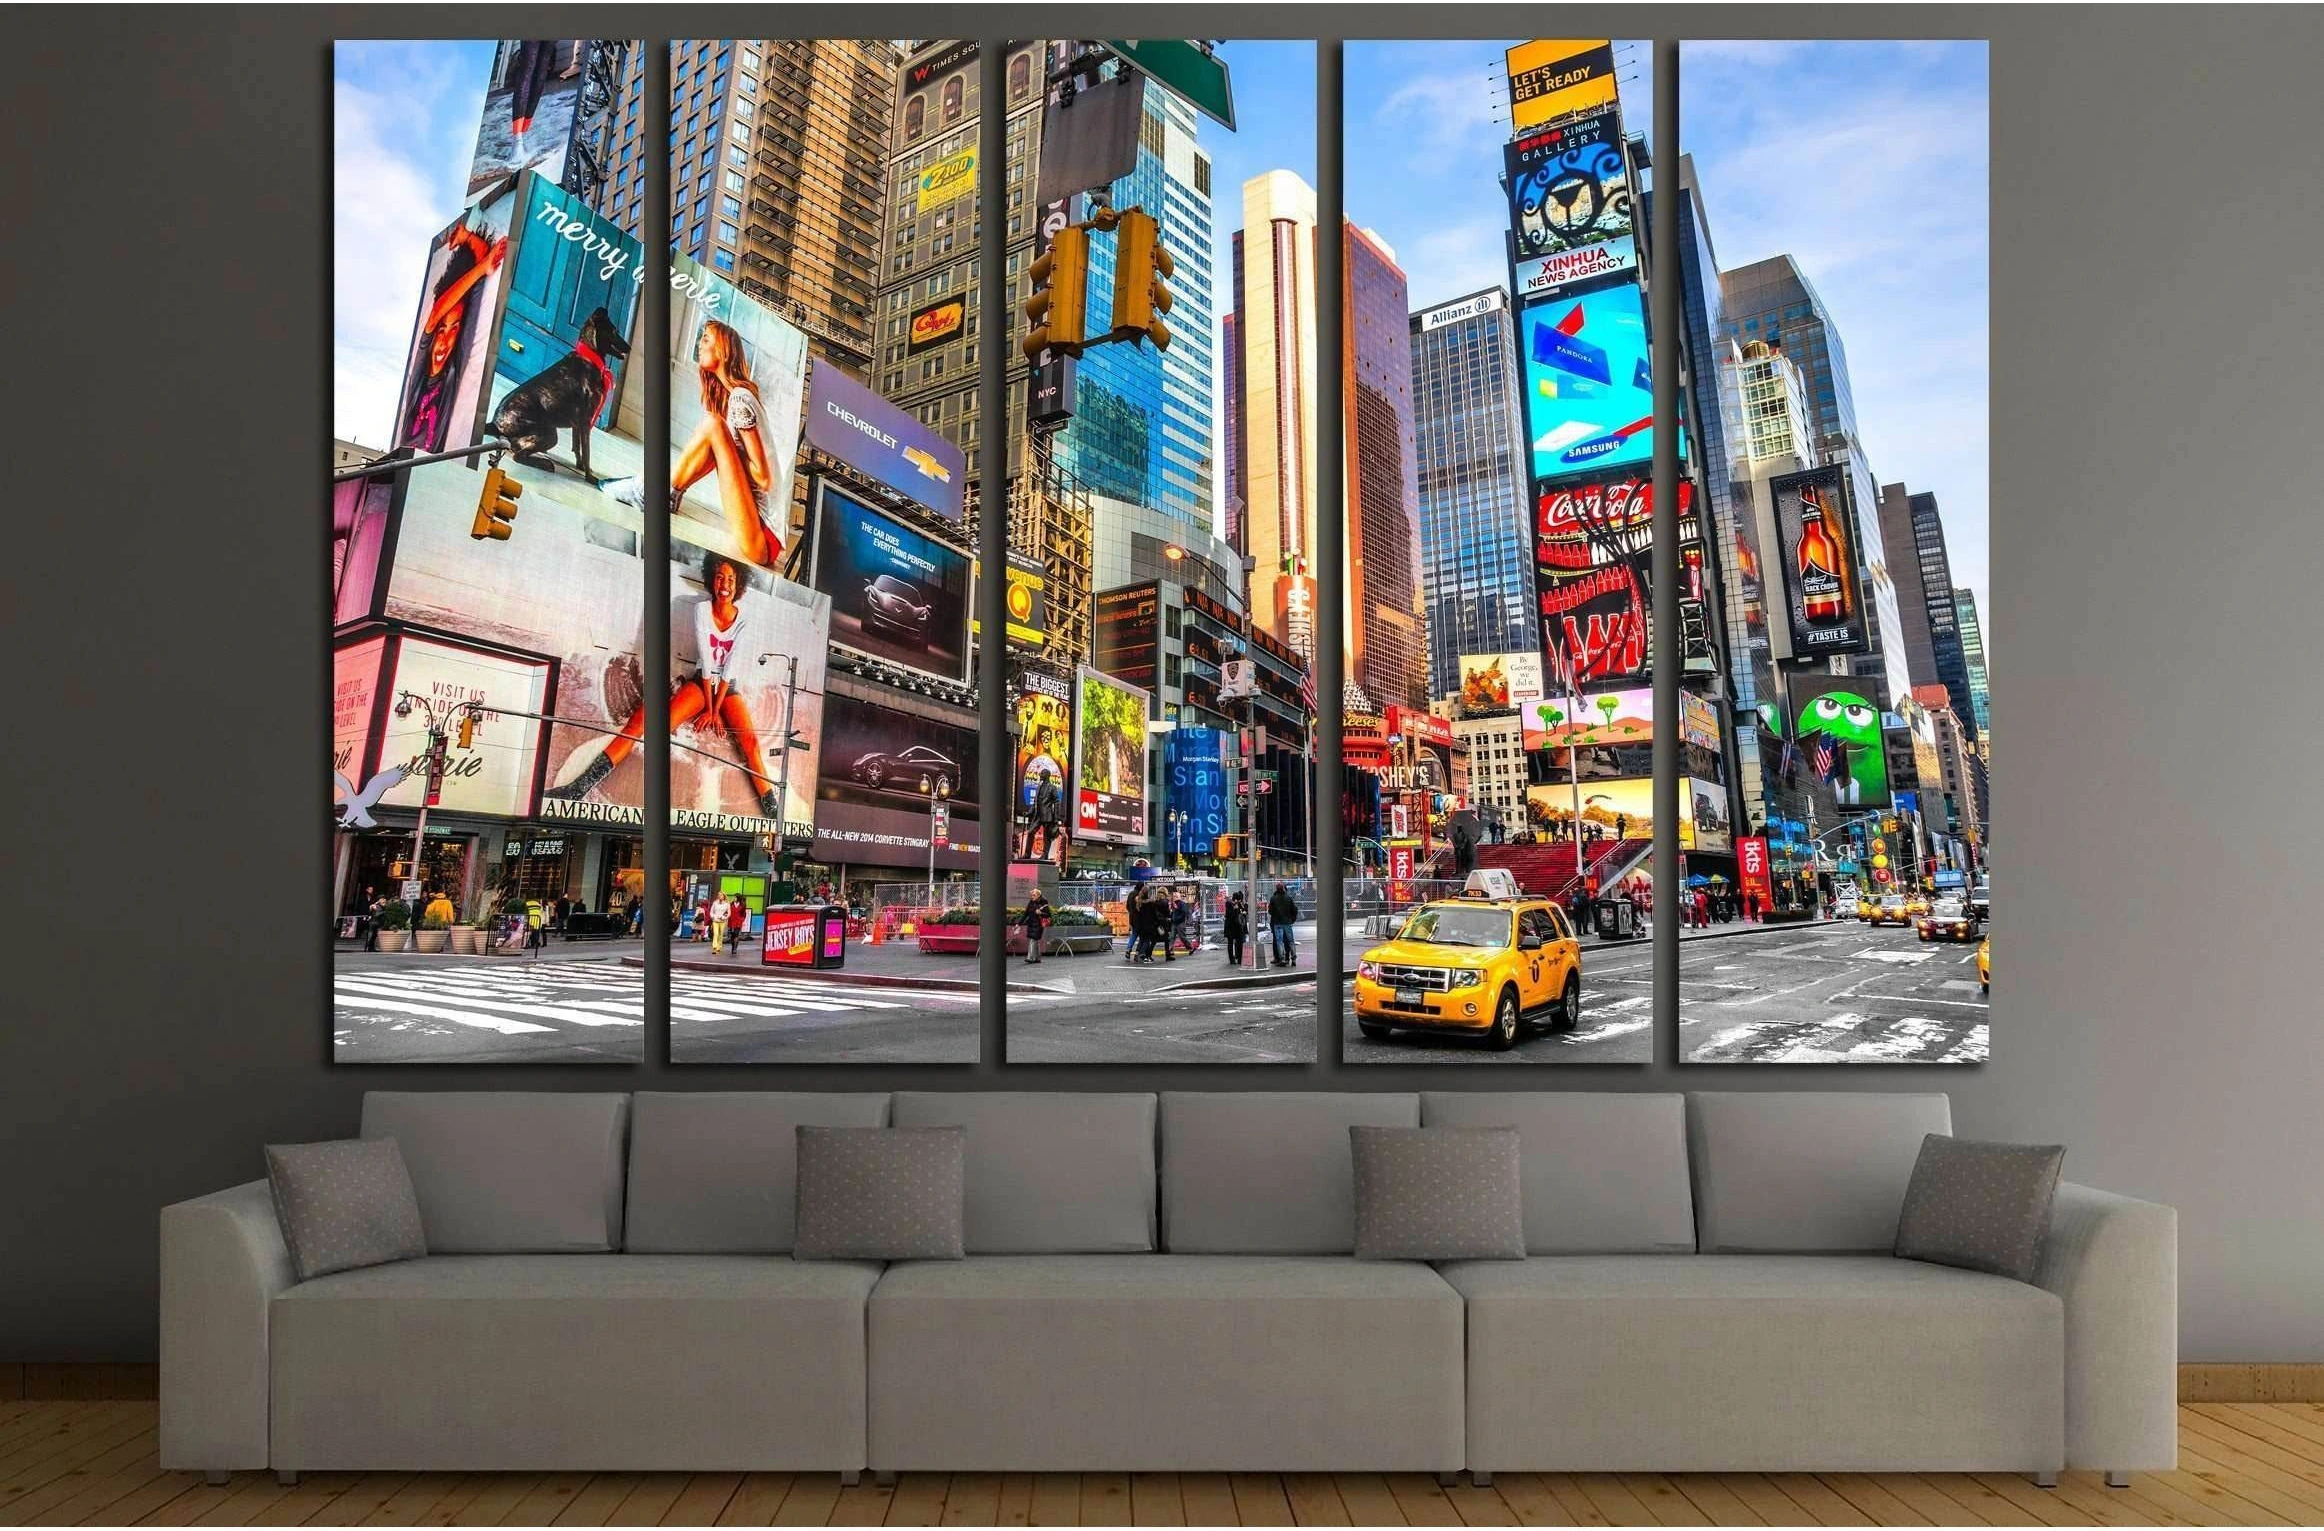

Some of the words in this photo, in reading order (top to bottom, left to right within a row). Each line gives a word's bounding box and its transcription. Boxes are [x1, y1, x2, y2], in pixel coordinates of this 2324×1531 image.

[932, 52, 959, 72] TIMES
[1514, 67, 1550, 89] LET'S
[1515, 83, 1542, 100] GET
[1546, 66, 1591, 91] READY
[1564, 120, 1600, 137] XINHUA
[1522, 131, 1601, 161] GALLERY
[536, 202, 629, 281] merry
[1541, 246, 1608, 274] XINHUA
[1528, 271, 1566, 289] NEWS
[1569, 255, 1626, 279] AGENCY
[1430, 304, 1472, 326] Allianz
[1556, 345, 1593, 363] PANDORA
[1038, 387, 1057, 399] NYC
[827, 401, 897, 449] CHEVROLET
[1568, 441, 1620, 457] SAMSUNG
[861, 522, 873, 534] THE
[873, 528, 884, 539] CAR
[885, 534, 899, 546] DOES
[873, 538, 907, 559] EVERYTHING
[907, 553, 935, 572] PERFECTLY
[1007, 583, 1031, 623] Q
[1129, 588, 1156, 599] REUTERS
[1808, 630, 1839, 642] #TASTE
[1840, 629, 1849, 639] IS
[433, 681, 465, 699] VISIT
[470, 689, 486, 702] US
[1024, 672, 1039, 686] THE
[1041, 676, 1069, 694] BIGGEST
[1183, 756, 1201, 764] Morgan
[544, 801, 645, 824] AMERICAN
[677, 811, 726, 830] EAGLE
[818, 828, 831, 839] THE
[831, 830, 860, 841] ALL-NEW
[860, 833, 874, 843] 2014
[875, 835, 903, 846] CORVETTE
[904, 837, 929, 848] STINGRAY
[1396, 851, 1409, 879] tkts
[1744, 841, 1761, 873] tkts
[765, 928, 793, 951] JERSEY
[794, 925, 815, 947] BOYS
